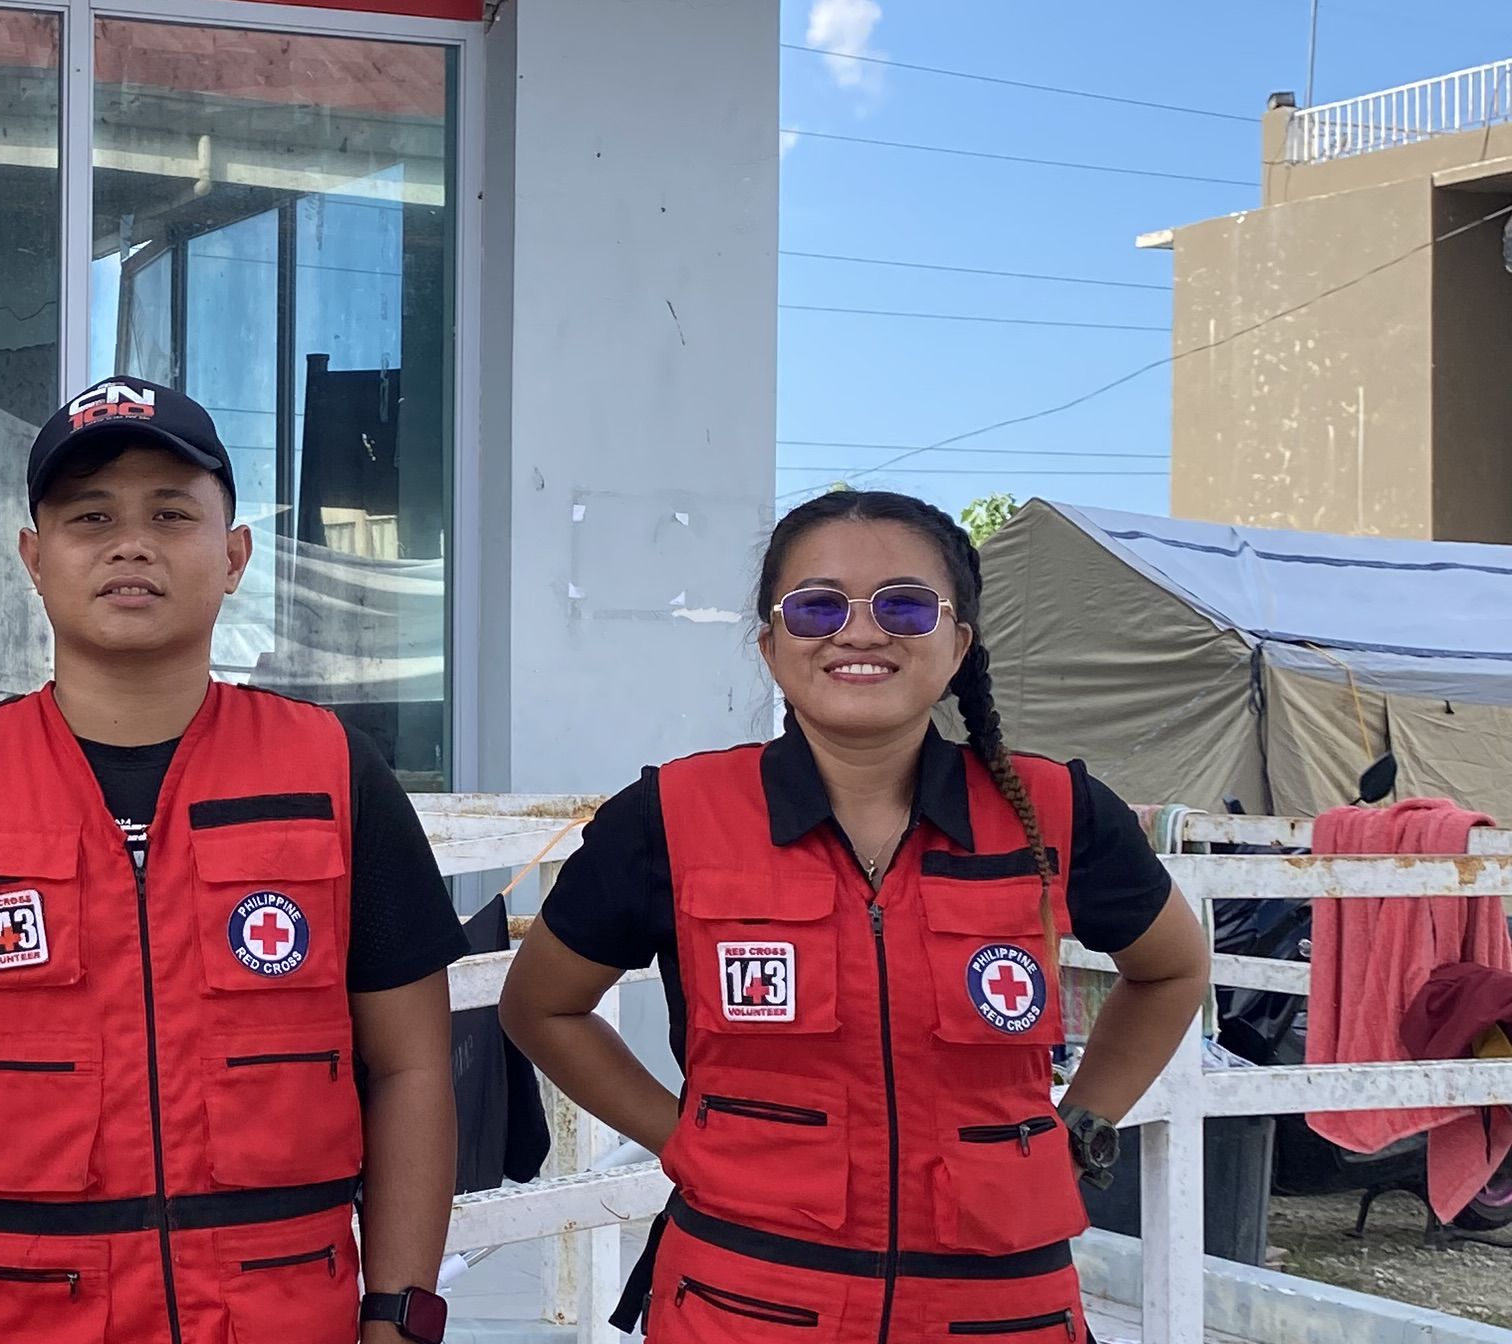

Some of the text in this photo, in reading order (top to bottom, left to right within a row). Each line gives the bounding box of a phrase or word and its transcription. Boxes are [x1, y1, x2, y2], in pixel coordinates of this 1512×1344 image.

[69, 385, 155, 416] CN
[68, 402, 154, 431] 100
[237, 894, 302, 922] PHILIPPINE
[235, 946, 302, 974] RED CROSS
[725, 947, 786, 956] RED CROSS
[972, 947, 1038, 975] PHILIPPINE
[727, 960, 786, 1004] 143
[727, 1007, 787, 1017] VOLUNTEER
[979, 1002, 1041, 1032] RED CROSS
